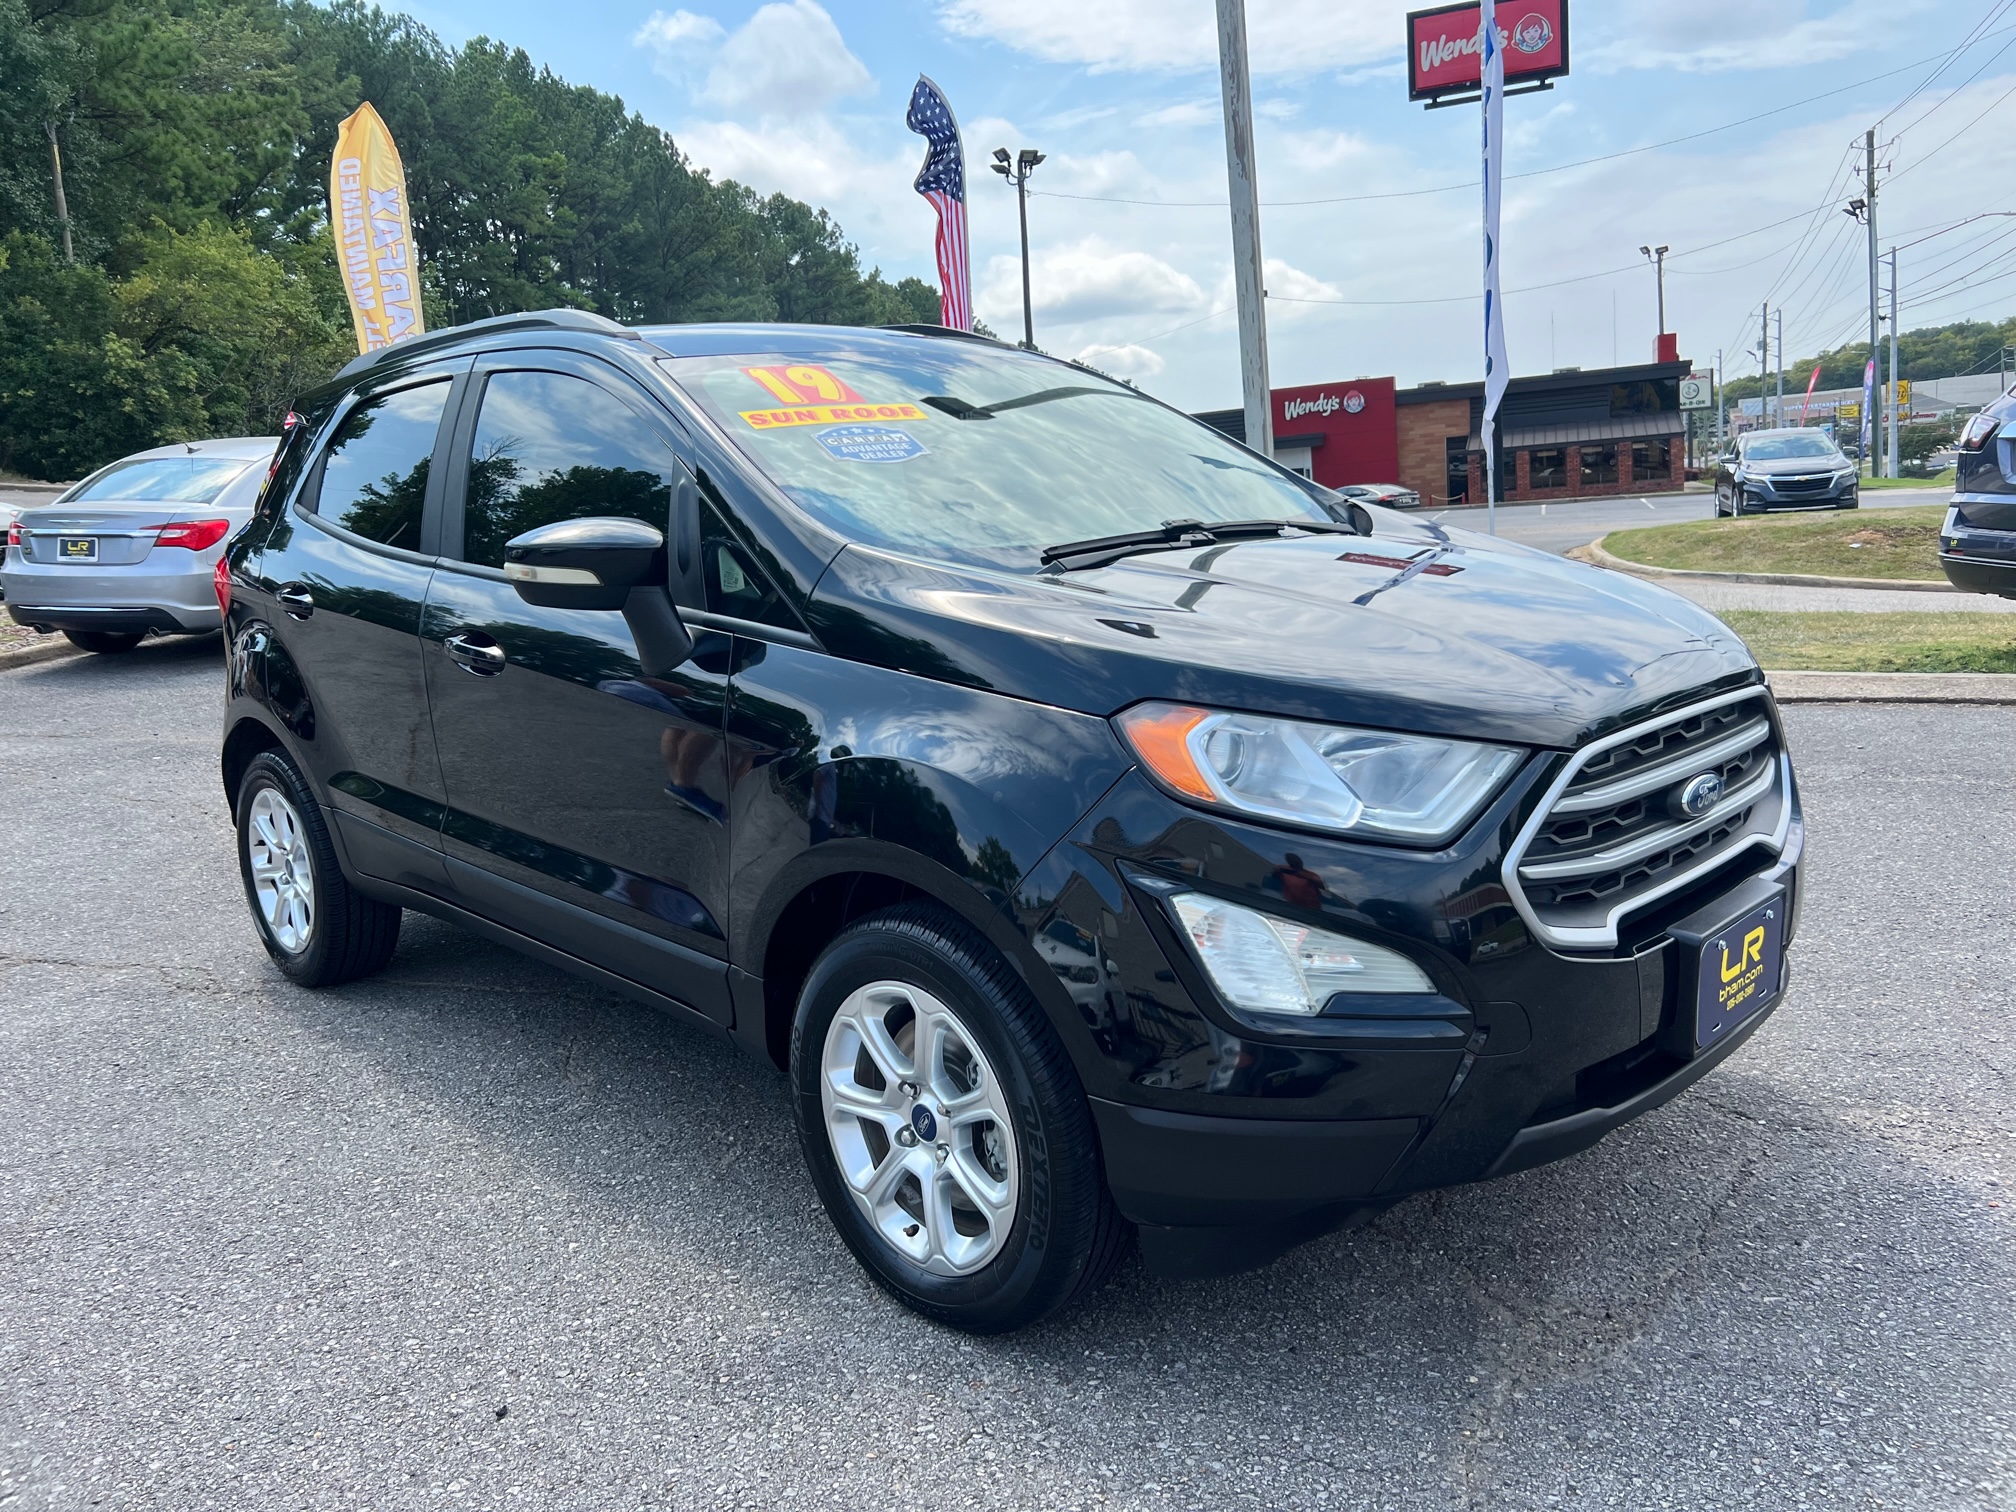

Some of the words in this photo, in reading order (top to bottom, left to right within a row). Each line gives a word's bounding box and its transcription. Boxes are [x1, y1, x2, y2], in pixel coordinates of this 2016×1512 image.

[1421, 22, 1508, 72] Wend's
[748, 366, 846, 404] 19
[748, 410, 818, 426] SUN
[829, 406, 919, 420] ROOF
[1284, 393, 1340, 421] Wendy's
[825, 433, 910, 447] CARFAX
[841, 442, 912, 454] ADVANTAGE
[859, 450, 909, 460] DEALER
[67, 541, 89, 551] LR
[1697, 778, 1719, 808] Ford
[1720, 925, 1765, 983] LR
[1719, 963, 1763, 1002] bham.com
[1020, 1095, 1051, 1249] DEXTERO
